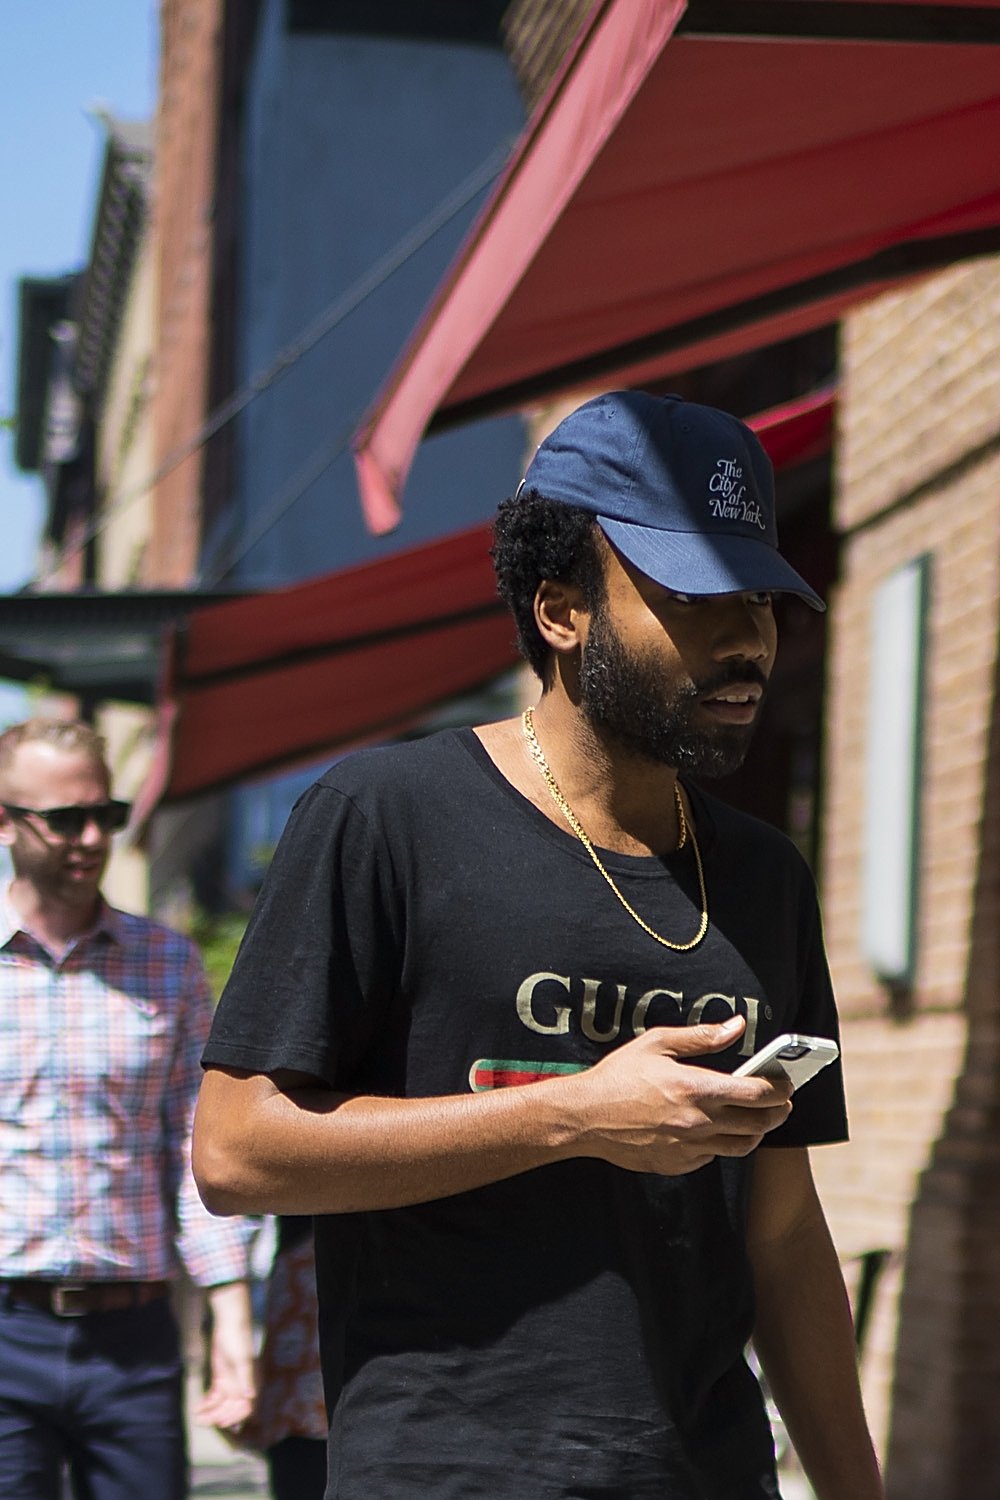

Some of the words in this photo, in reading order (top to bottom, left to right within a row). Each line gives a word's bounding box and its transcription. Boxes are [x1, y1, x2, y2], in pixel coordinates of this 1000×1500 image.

[716, 458, 742, 478] The
[709, 473, 738, 498] City
[729, 486, 746, 506] of
[708, 500, 741, 519] New
[740, 501, 766, 530] York
